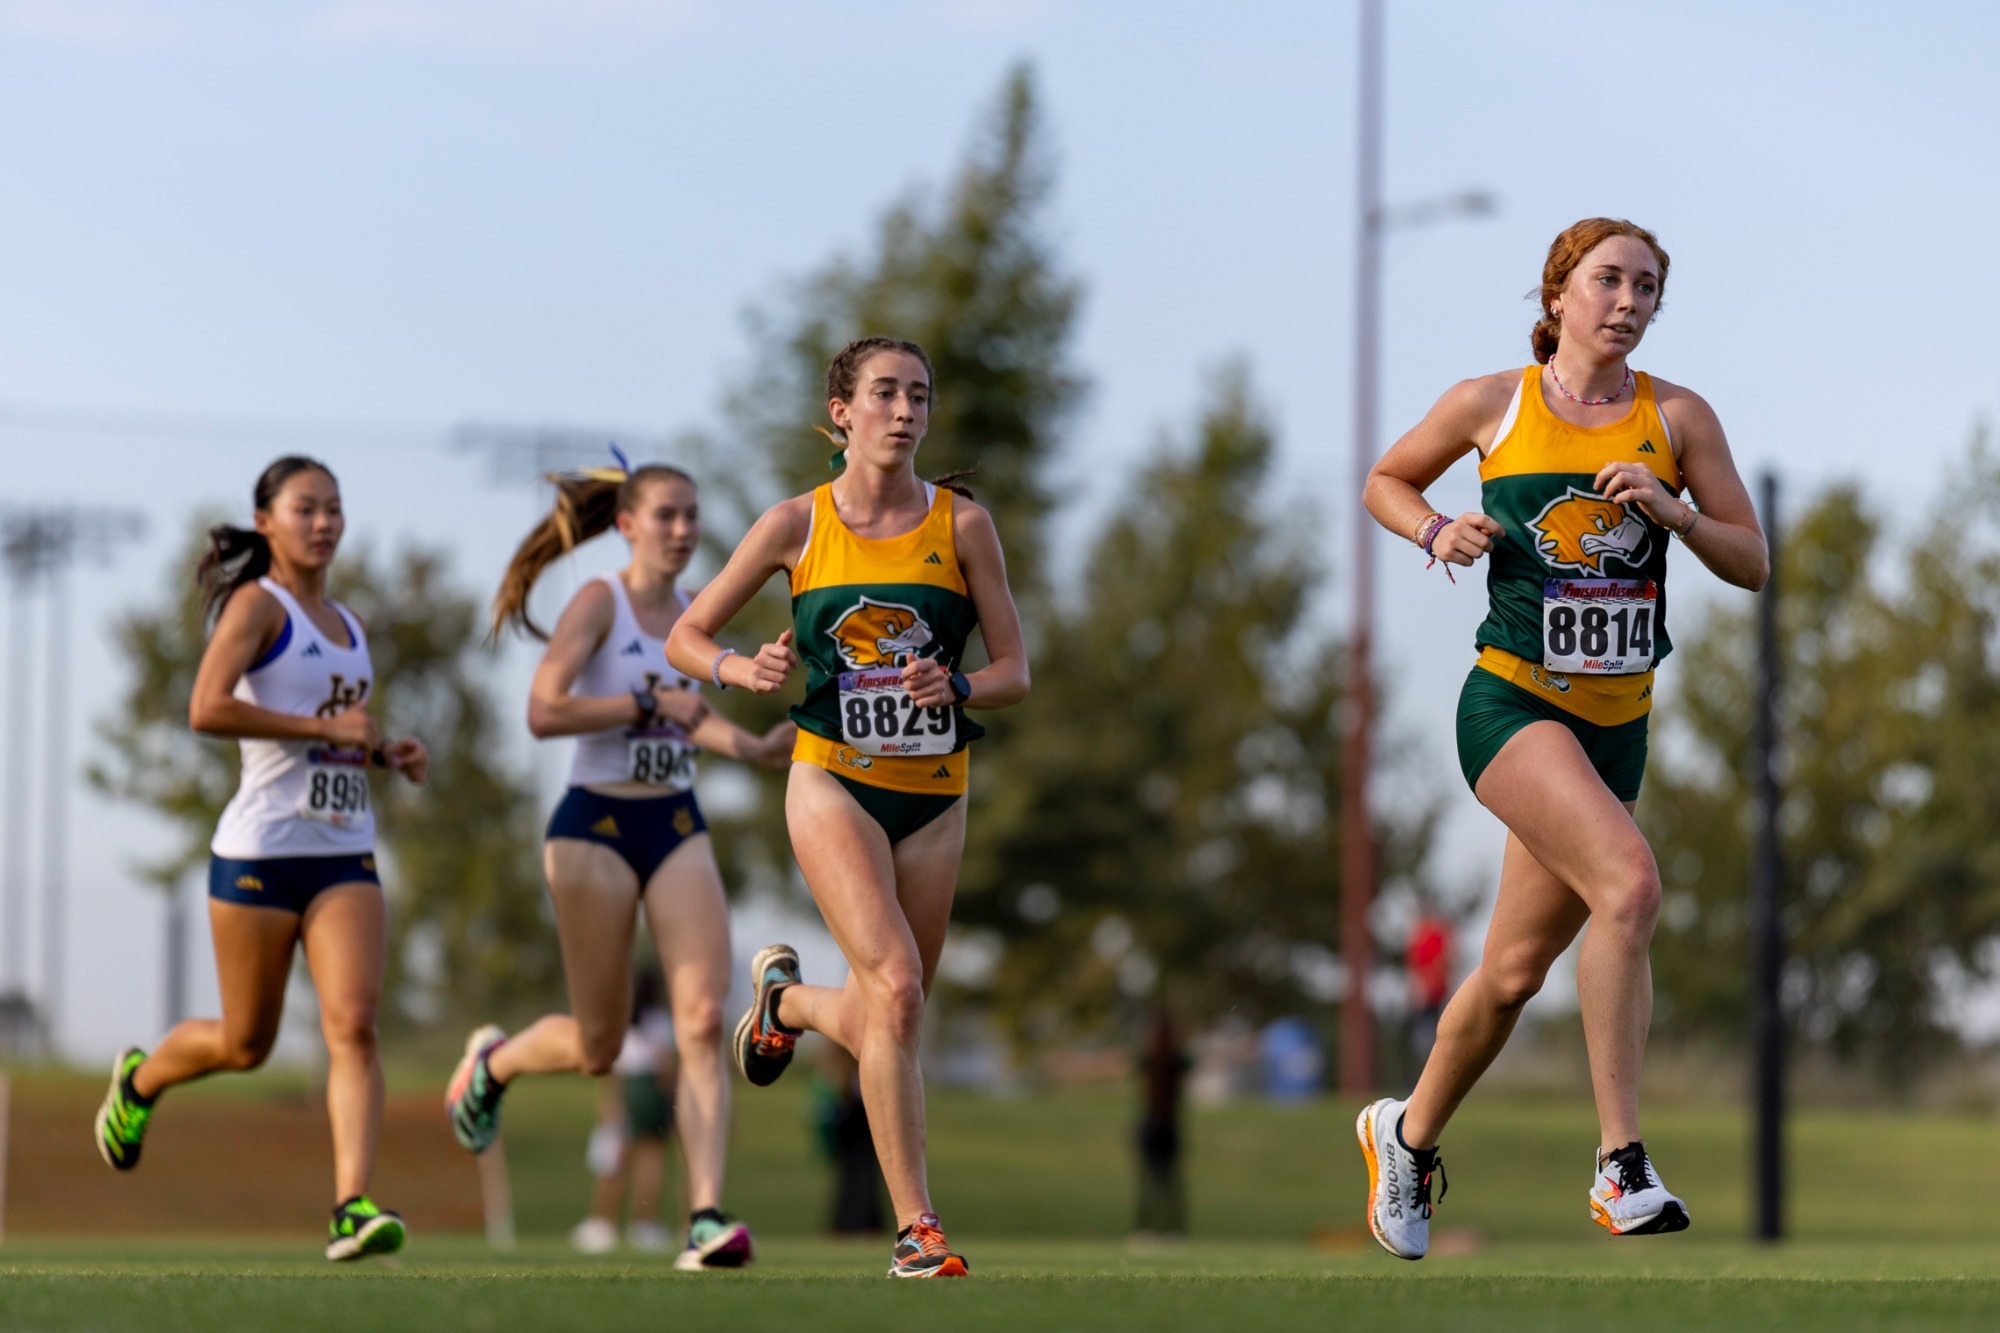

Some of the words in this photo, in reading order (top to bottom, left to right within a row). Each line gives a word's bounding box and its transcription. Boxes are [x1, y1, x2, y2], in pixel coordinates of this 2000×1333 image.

[1548, 606, 1652, 657] 8814
[1582, 660, 1624, 671] MileSplit
[845, 694, 951, 738] 8829
[880, 742, 921, 753] MileSplit
[1385, 1142, 1403, 1220] BROOKS
